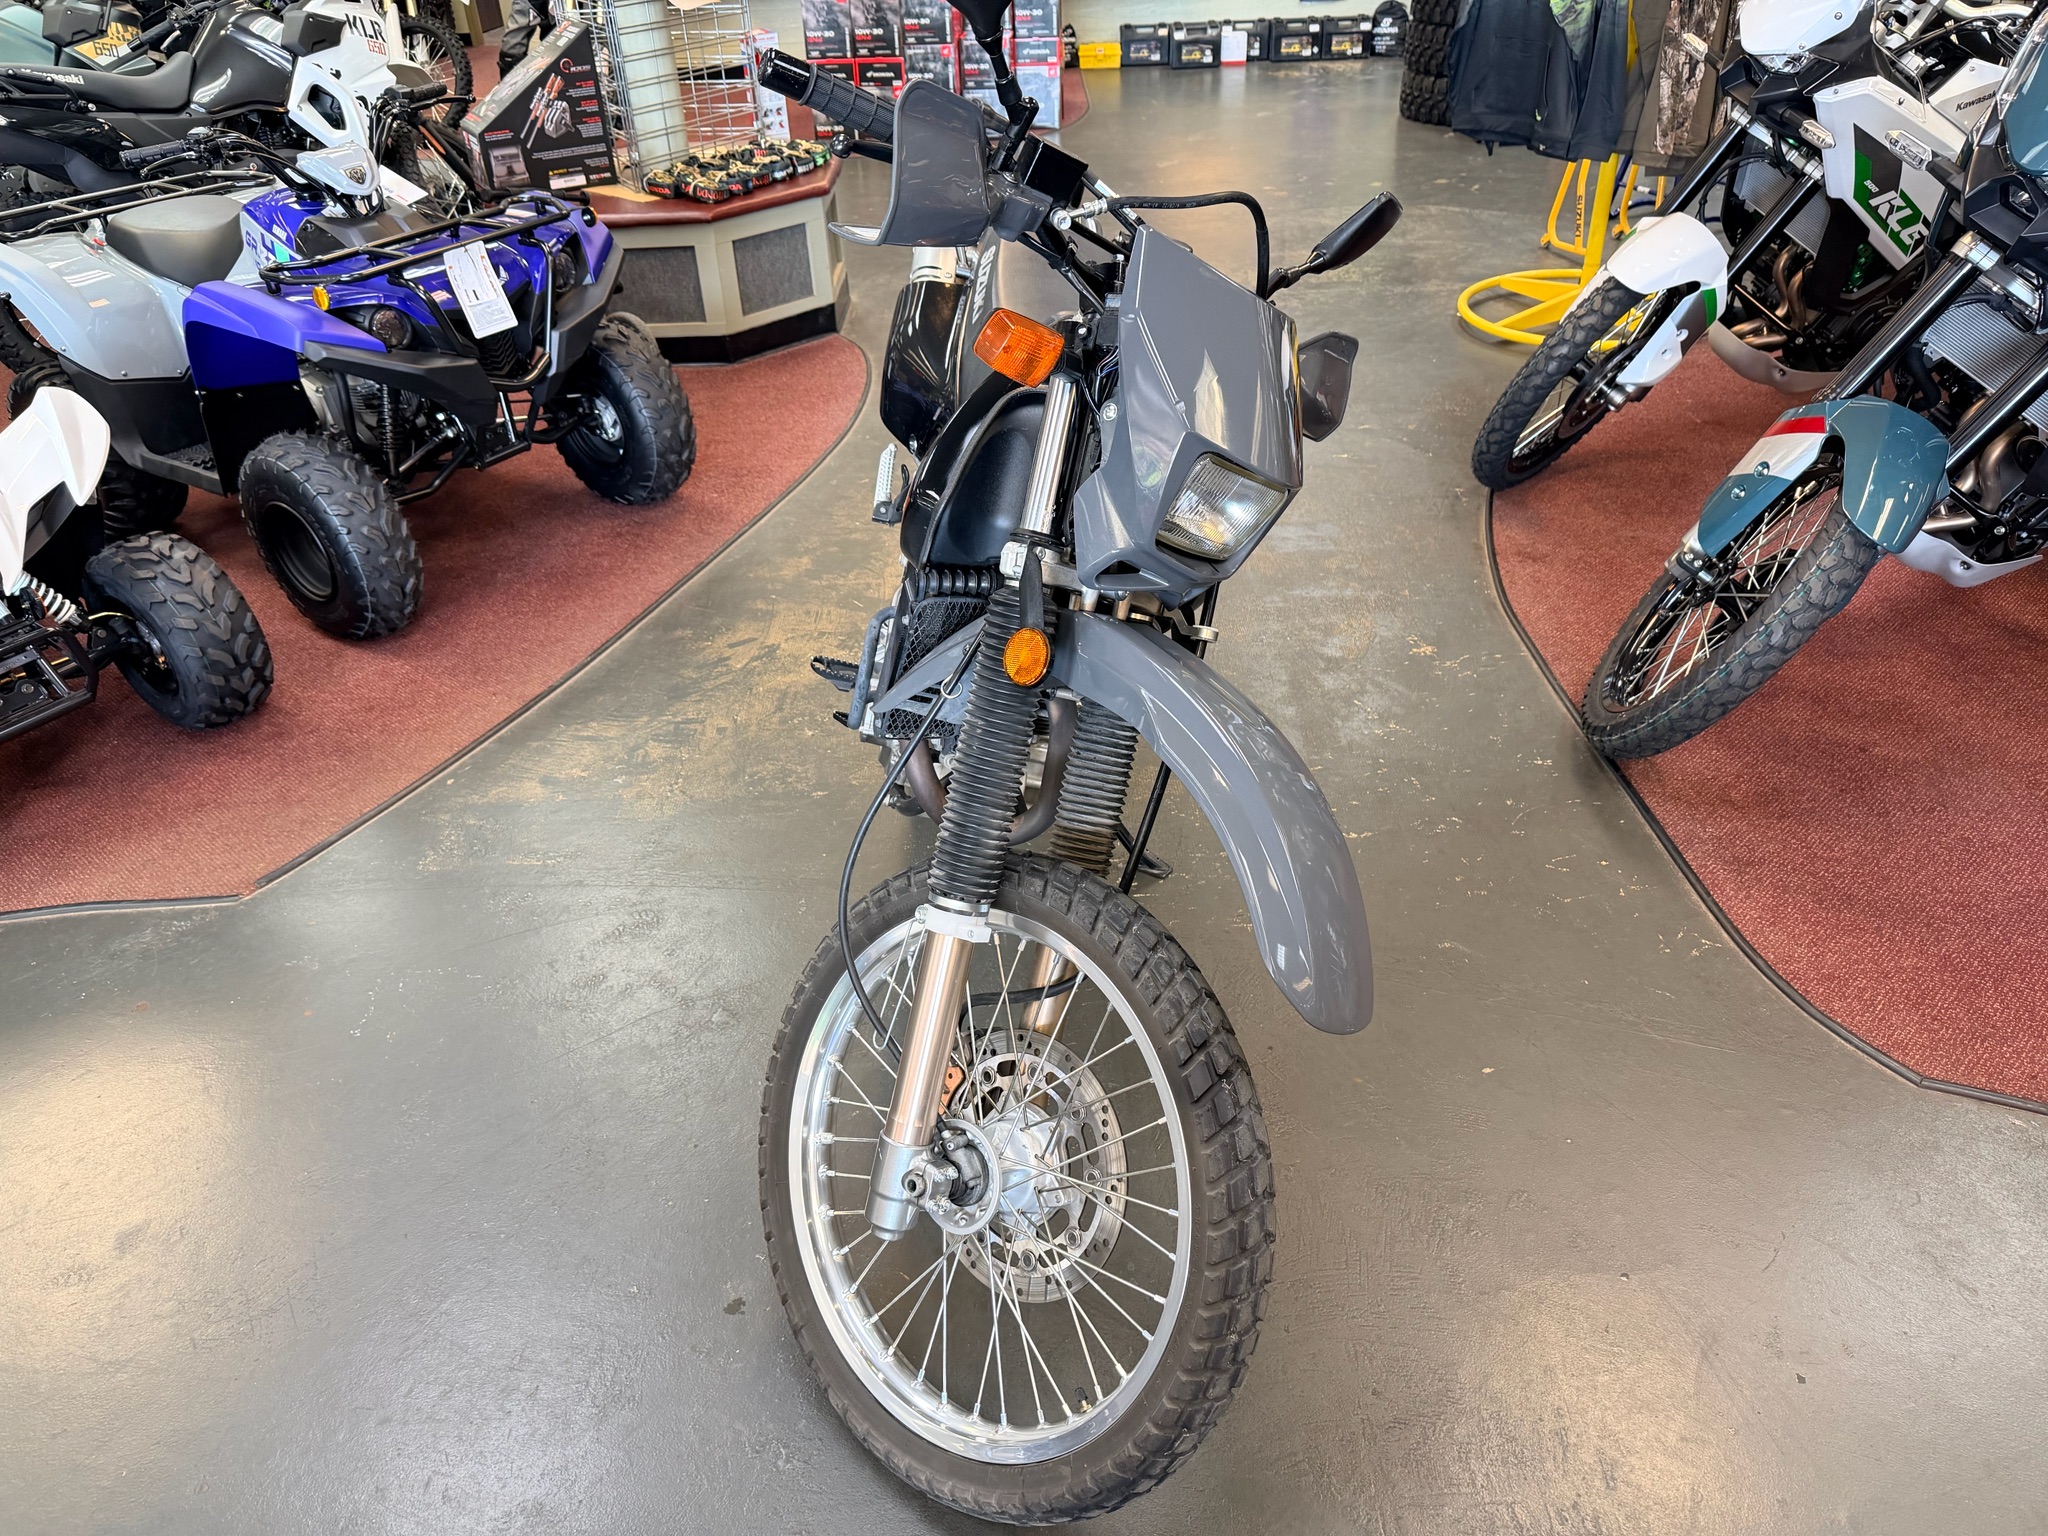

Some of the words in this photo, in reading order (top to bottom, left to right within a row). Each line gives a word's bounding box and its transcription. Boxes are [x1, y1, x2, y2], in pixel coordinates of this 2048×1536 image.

[1015, 8, 1043, 16] 10W-30
[344, 13, 387, 43] KLR
[806, 30, 835, 38] 10W-30
[92, 41, 120, 58] 650
[367, 39, 387, 56] 650
[1955, 90, 1997, 112] Kawasak
[815, 124, 845, 132] 10W-30
[1863, 179, 1880, 193] 500
[1575, 195, 1583, 238] SUZUKI
[1868, 190, 1930, 246] KLE
[972, 245, 996, 325] SUZUKI
